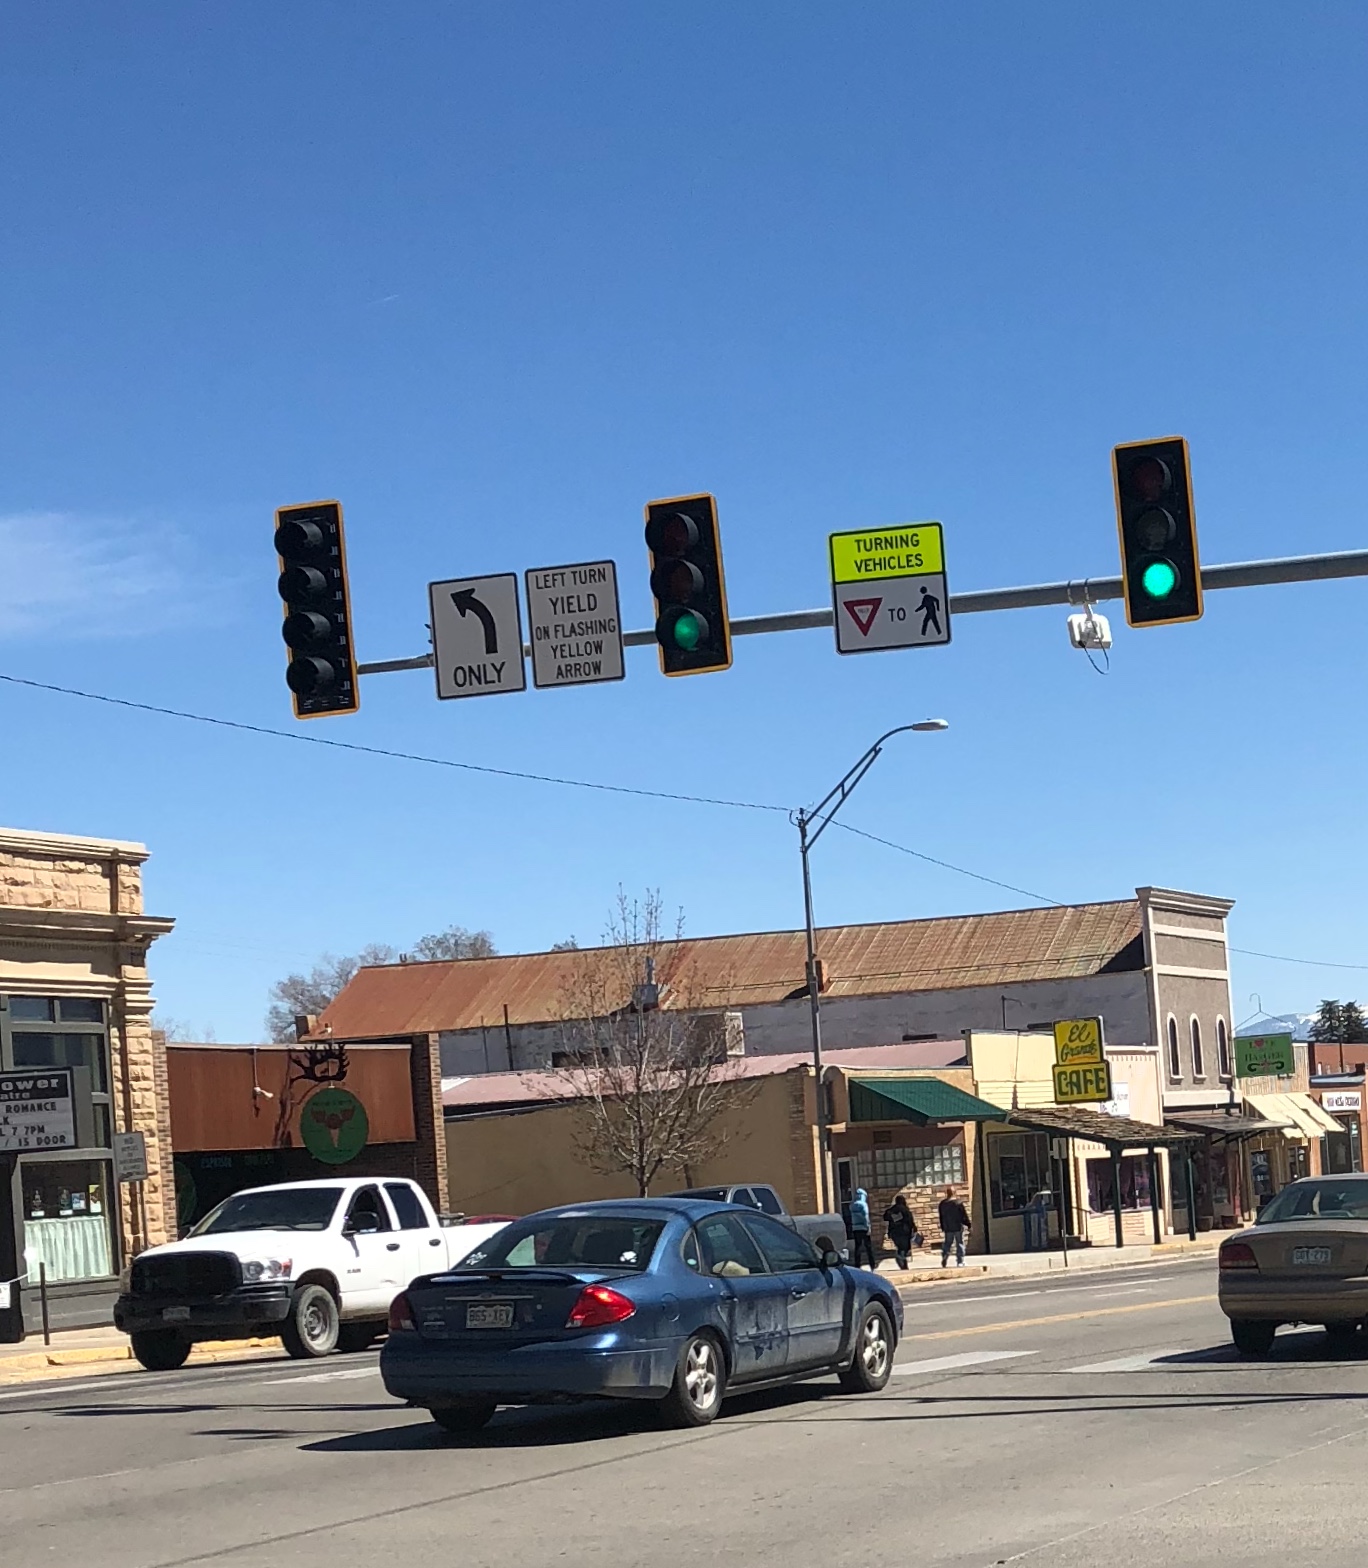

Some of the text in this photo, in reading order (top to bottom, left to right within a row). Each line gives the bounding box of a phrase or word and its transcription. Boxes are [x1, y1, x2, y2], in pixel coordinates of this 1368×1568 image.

[855, 533, 920, 553] TURNING
[854, 553, 924, 573] VEHICLES
[536, 567, 607, 589] LEFT TURN
[549, 593, 598, 615] YIELD
[888, 607, 906, 622] TO
[535, 618, 616, 641] ON FLASHING
[551, 640, 604, 659] YELLOW
[453, 661, 506, 688] ONLY
[556, 661, 602, 679] ARROW
[1068, 1022, 1091, 1043] El
[1057, 1068, 1107, 1096] CAFE
[5, 1102, 57, 1113] ROMANCE
[11, 1126, 18, 1136] 7
[24, 1125, 45, 1136] 7PM
[36, 1134, 67, 1146] DOOR
